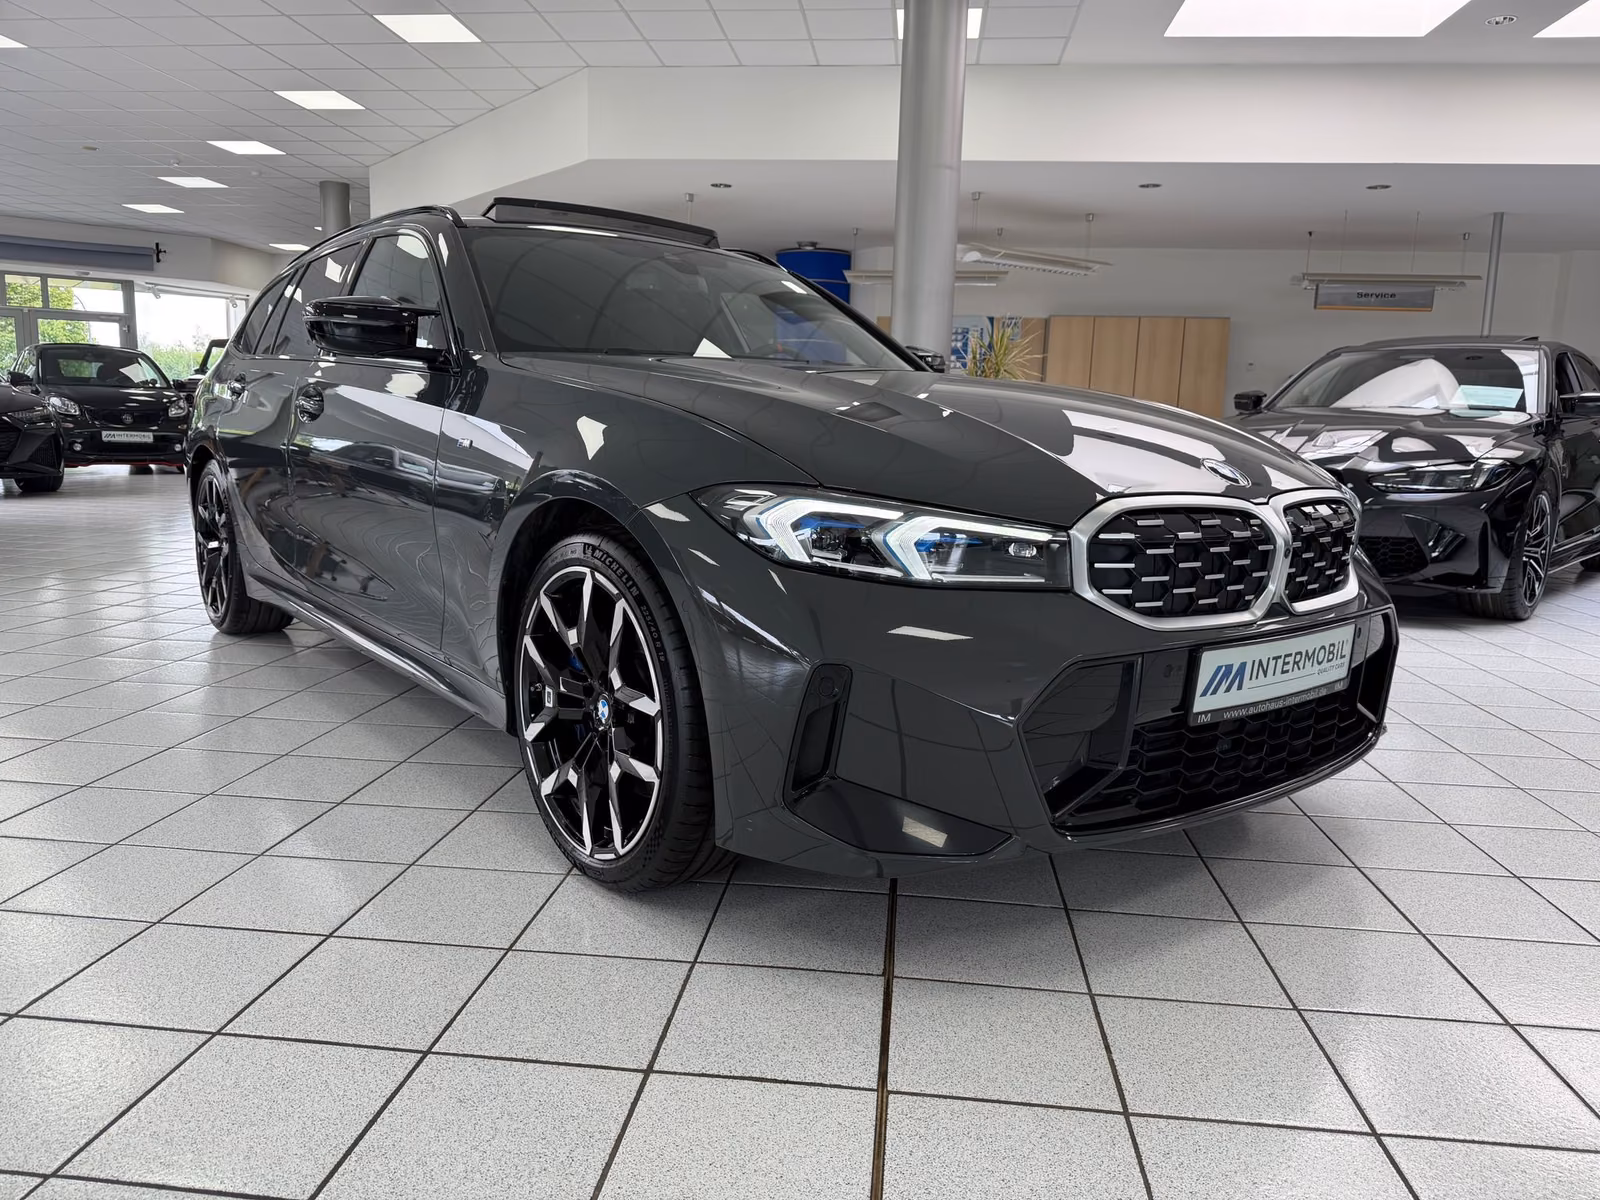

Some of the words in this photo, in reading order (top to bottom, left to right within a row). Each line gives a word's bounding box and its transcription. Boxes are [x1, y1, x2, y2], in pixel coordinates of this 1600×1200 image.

[1356, 291, 1397, 299] Service
[594, 549, 640, 596] MICHELIN
[1197, 713, 1211, 723] IM
[1223, 687, 1327, 718] www.autohaus-intermobil.de
